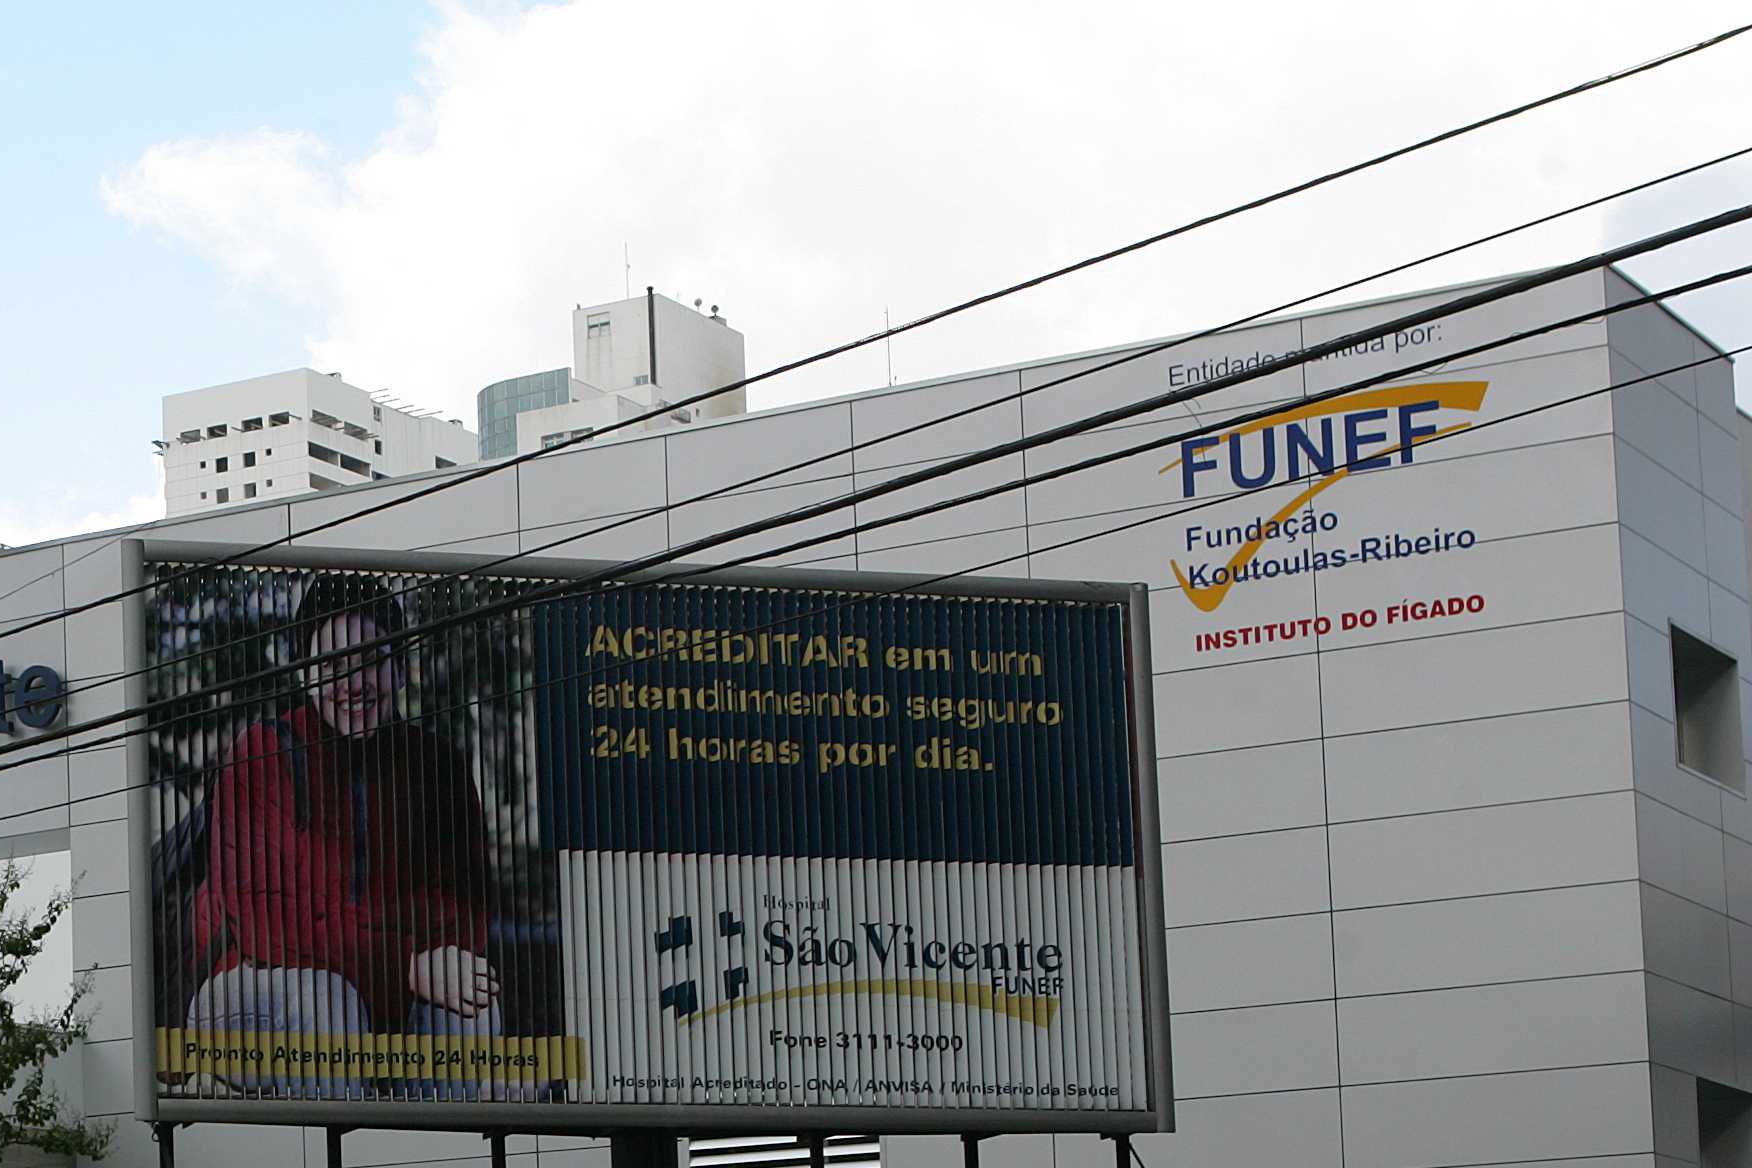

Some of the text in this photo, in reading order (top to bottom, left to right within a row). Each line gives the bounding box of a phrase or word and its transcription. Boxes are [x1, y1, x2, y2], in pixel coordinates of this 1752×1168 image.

[1395, 324, 1442, 354] por:
[1181, 400, 1440, 498] FUNEF
[1185, 510, 1338, 551] Fundação
[1189, 528, 1476, 589] Koutoulas-Ribeiro
[1196, 594, 1485, 652] INSTITUTO DO FÍGADO
[585, 625, 1043, 677] ACREDITAR em um
[588, 678, 1064, 730] atendimento seguro
[590, 725, 994, 773] 24 horas por dia.
[763, 894, 831, 911] Hospital
[763, 919, 1064, 973] São Vicente
[993, 976, 1065, 997] FUNEF
[185, 1042, 540, 1069] Pronto Atendimento 24 Horas
[769, 1029, 964, 1052] Fone 3111-3000
[613, 1075, 685, 1090] Hospital
[692, 1076, 788, 1090] Acreditado
[864, 1079, 934, 1093] ANVISA
[951, 1079, 1035, 1095] Ministério
[1041, 1082, 1061, 1096] da
[1066, 1082, 1120, 1097] Saúde
